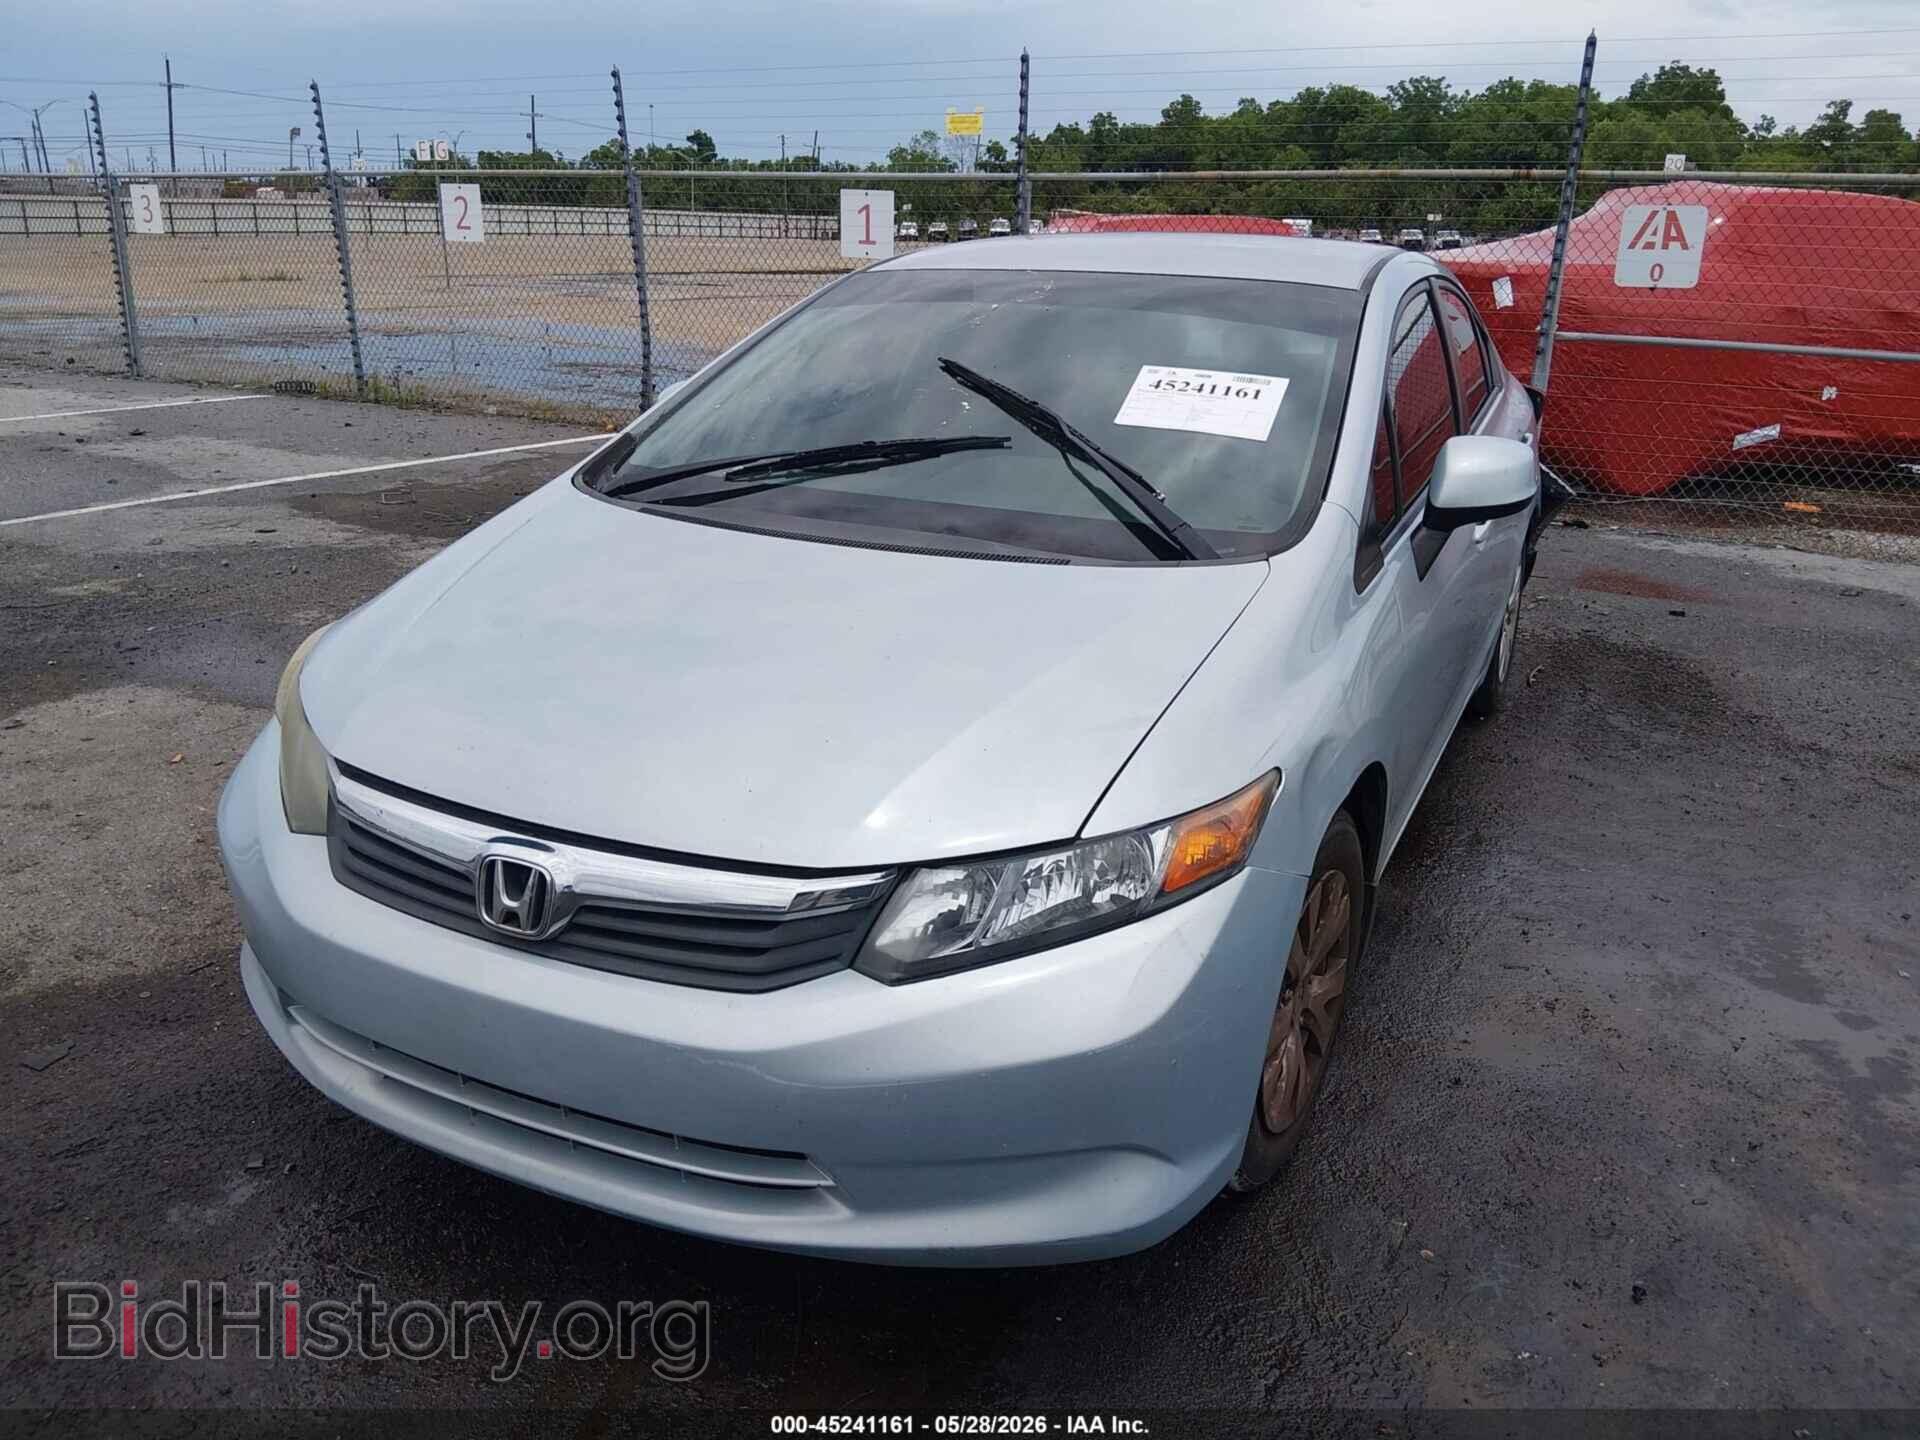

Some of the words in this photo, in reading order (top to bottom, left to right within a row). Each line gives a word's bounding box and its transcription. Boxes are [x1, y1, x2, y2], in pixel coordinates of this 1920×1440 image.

[436, 140, 447, 160] G
[140, 194, 153, 223] 3
[454, 195, 471, 230] 2
[857, 203, 876, 245] 1
[1650, 263, 1664, 282] 0
[1148, 378, 1262, 401] 45241161
